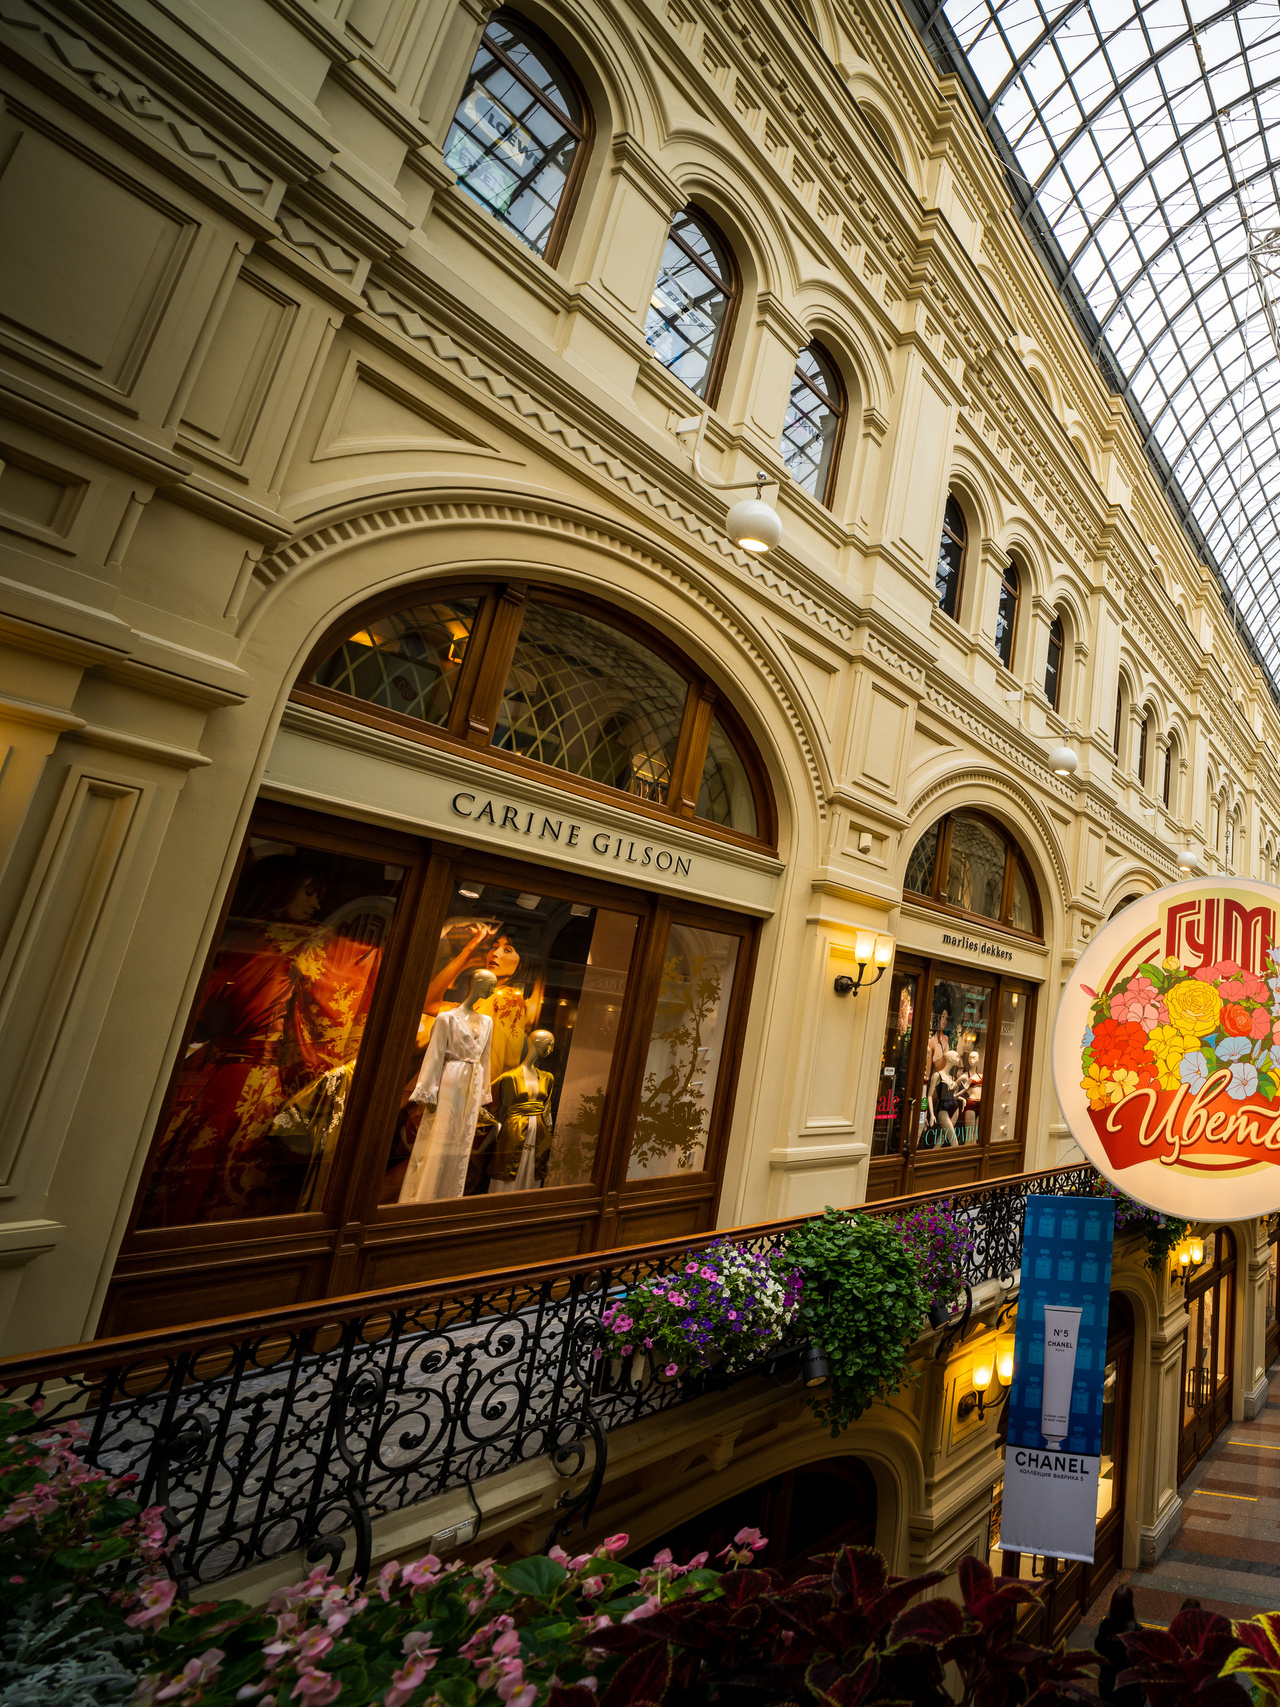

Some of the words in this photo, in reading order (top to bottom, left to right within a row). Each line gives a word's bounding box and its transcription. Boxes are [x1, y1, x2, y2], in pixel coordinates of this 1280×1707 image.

[451, 792, 581, 846] CARINE
[592, 832, 692, 876] GILSON
[1165, 898, 1276, 978] ГУМ
[875, 1089, 899, 1112] ale
[1047, 1341, 1073, 1349] CHANEL
[1015, 1451, 1089, 1474] CHANEL
[1020, 1468, 1051, 1477] КОЛЛЕКЦИЯ
[1053, 1473, 1079, 1481] ФАБРИКА
